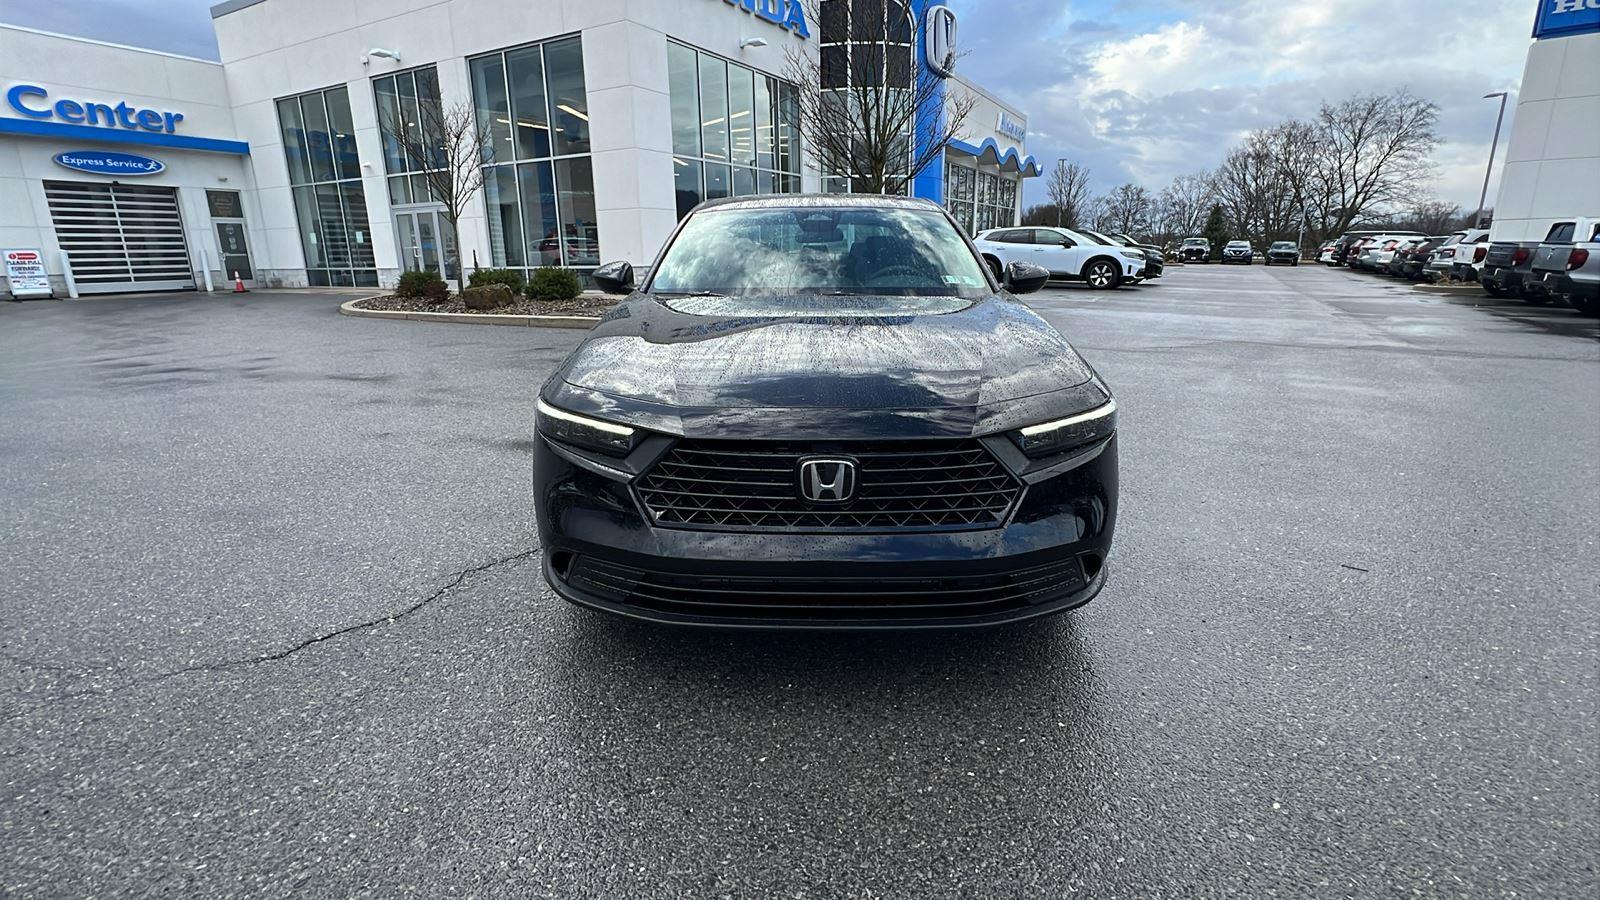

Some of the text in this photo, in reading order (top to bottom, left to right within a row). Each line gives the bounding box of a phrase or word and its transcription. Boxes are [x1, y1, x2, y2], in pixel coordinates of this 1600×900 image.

[7, 84, 185, 133] Center
[62, 155, 144, 169] Express Service
